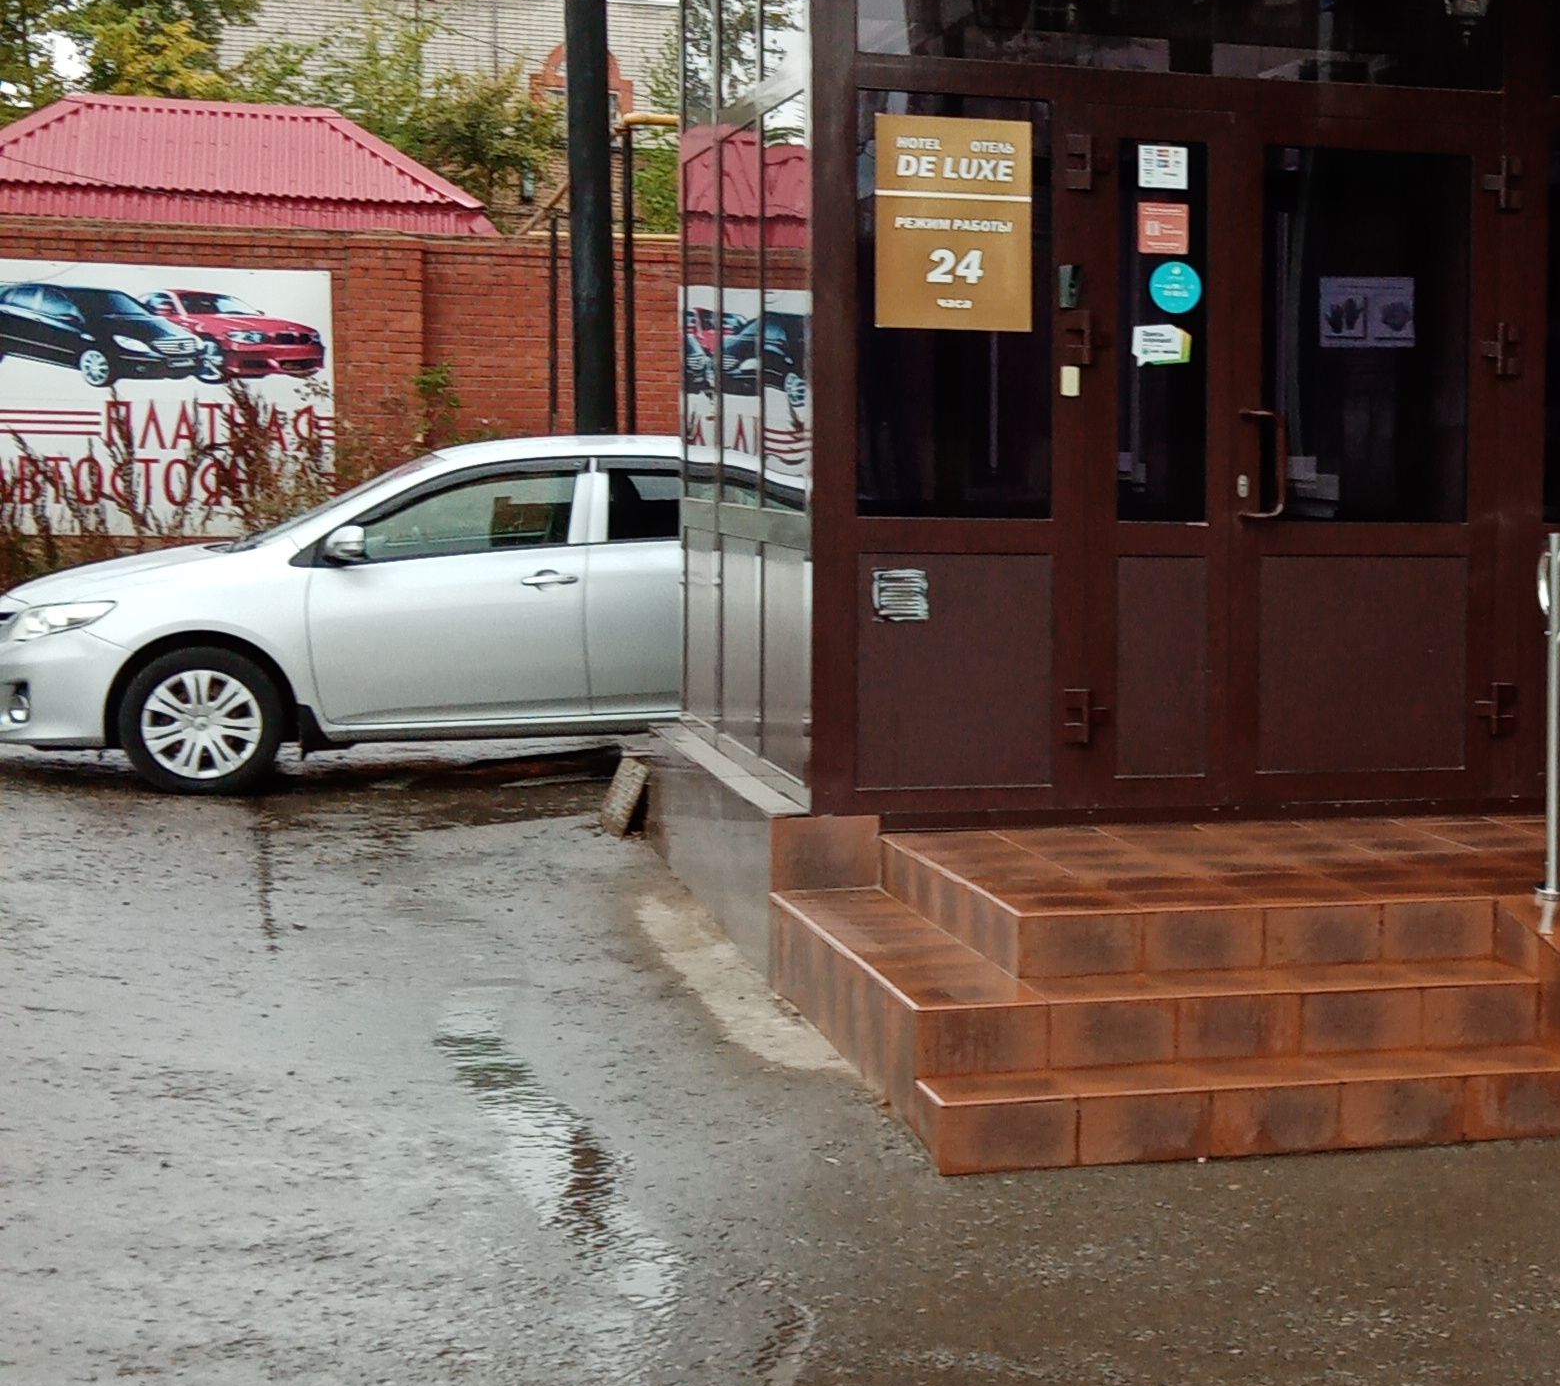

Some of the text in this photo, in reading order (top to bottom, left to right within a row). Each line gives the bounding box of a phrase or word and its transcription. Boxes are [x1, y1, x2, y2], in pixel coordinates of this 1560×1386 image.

[896, 136, 942, 151] HOTEL
[970, 139, 1016, 154] ОТЕЛЬ
[896, 154, 1015, 182] DE LUXE
[894, 216, 1013, 233] РЕЖИМ РАБОТЫ
[926, 248, 984, 284] 24
